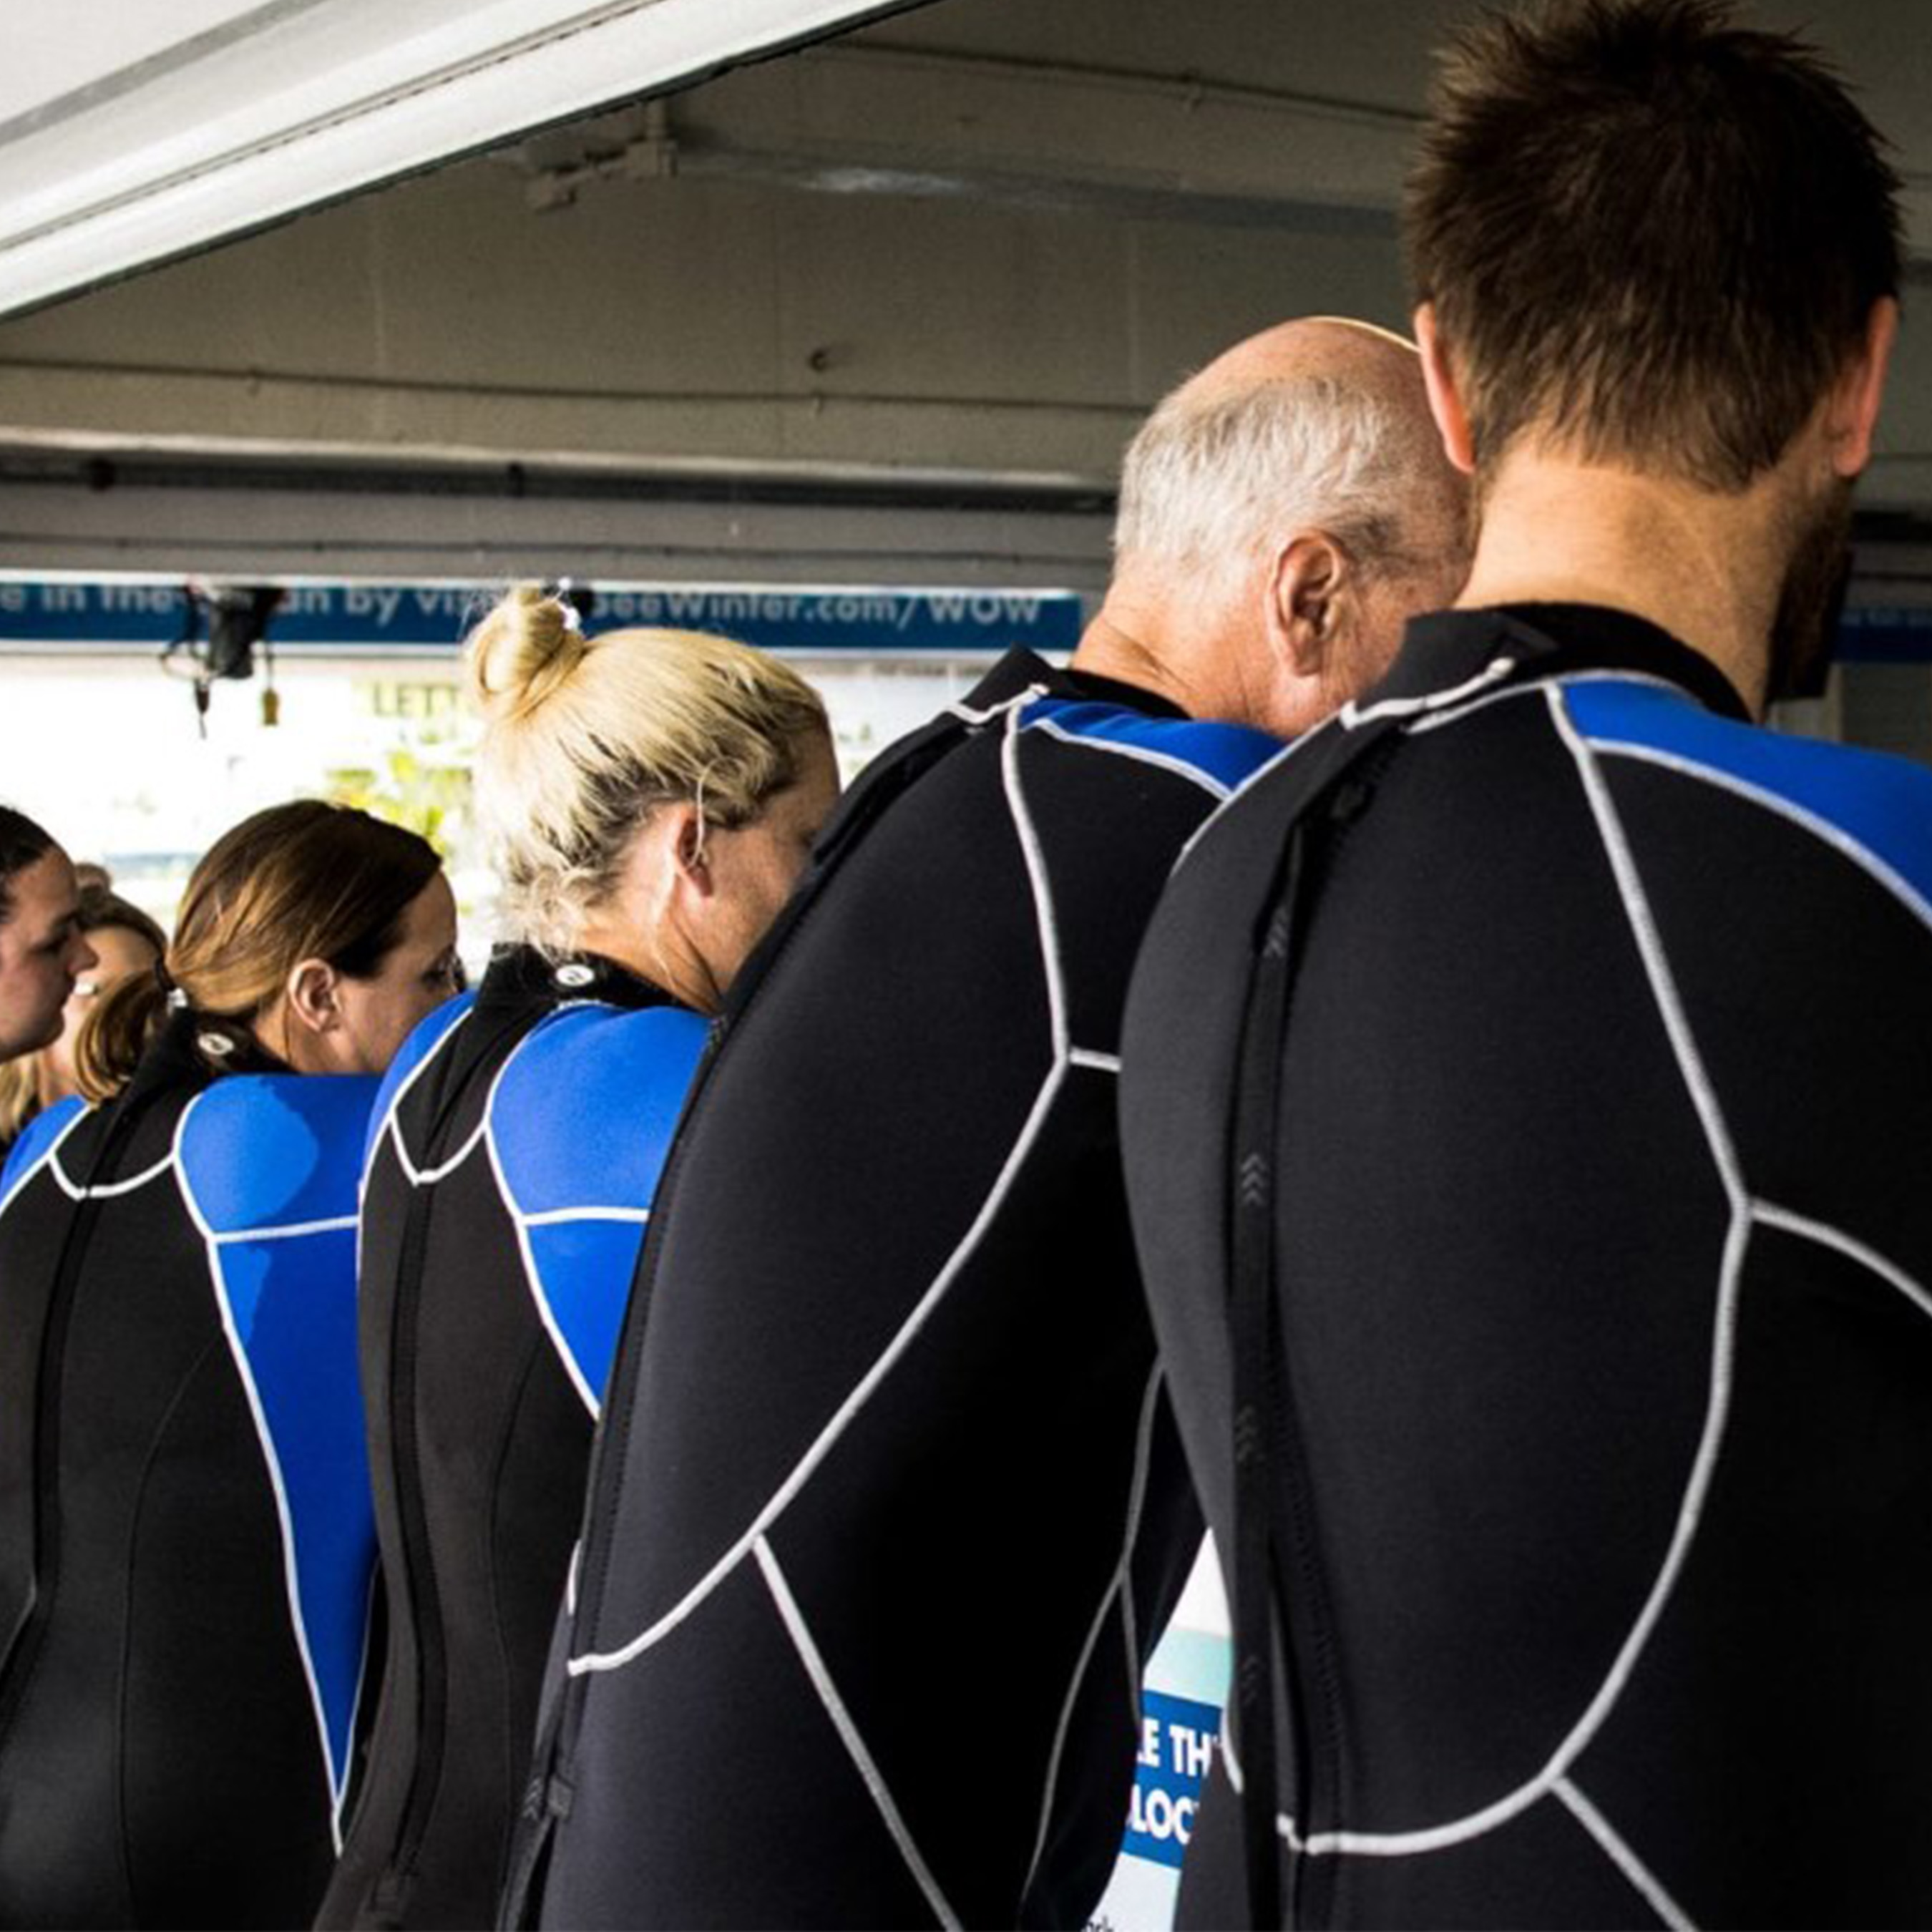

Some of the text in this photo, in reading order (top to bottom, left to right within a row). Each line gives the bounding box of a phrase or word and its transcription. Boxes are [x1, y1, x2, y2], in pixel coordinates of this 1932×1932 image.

[346, 588, 398, 628] by
[1136, 1716, 1219, 1778] E TH
[1126, 1783, 1200, 1846] LOC
